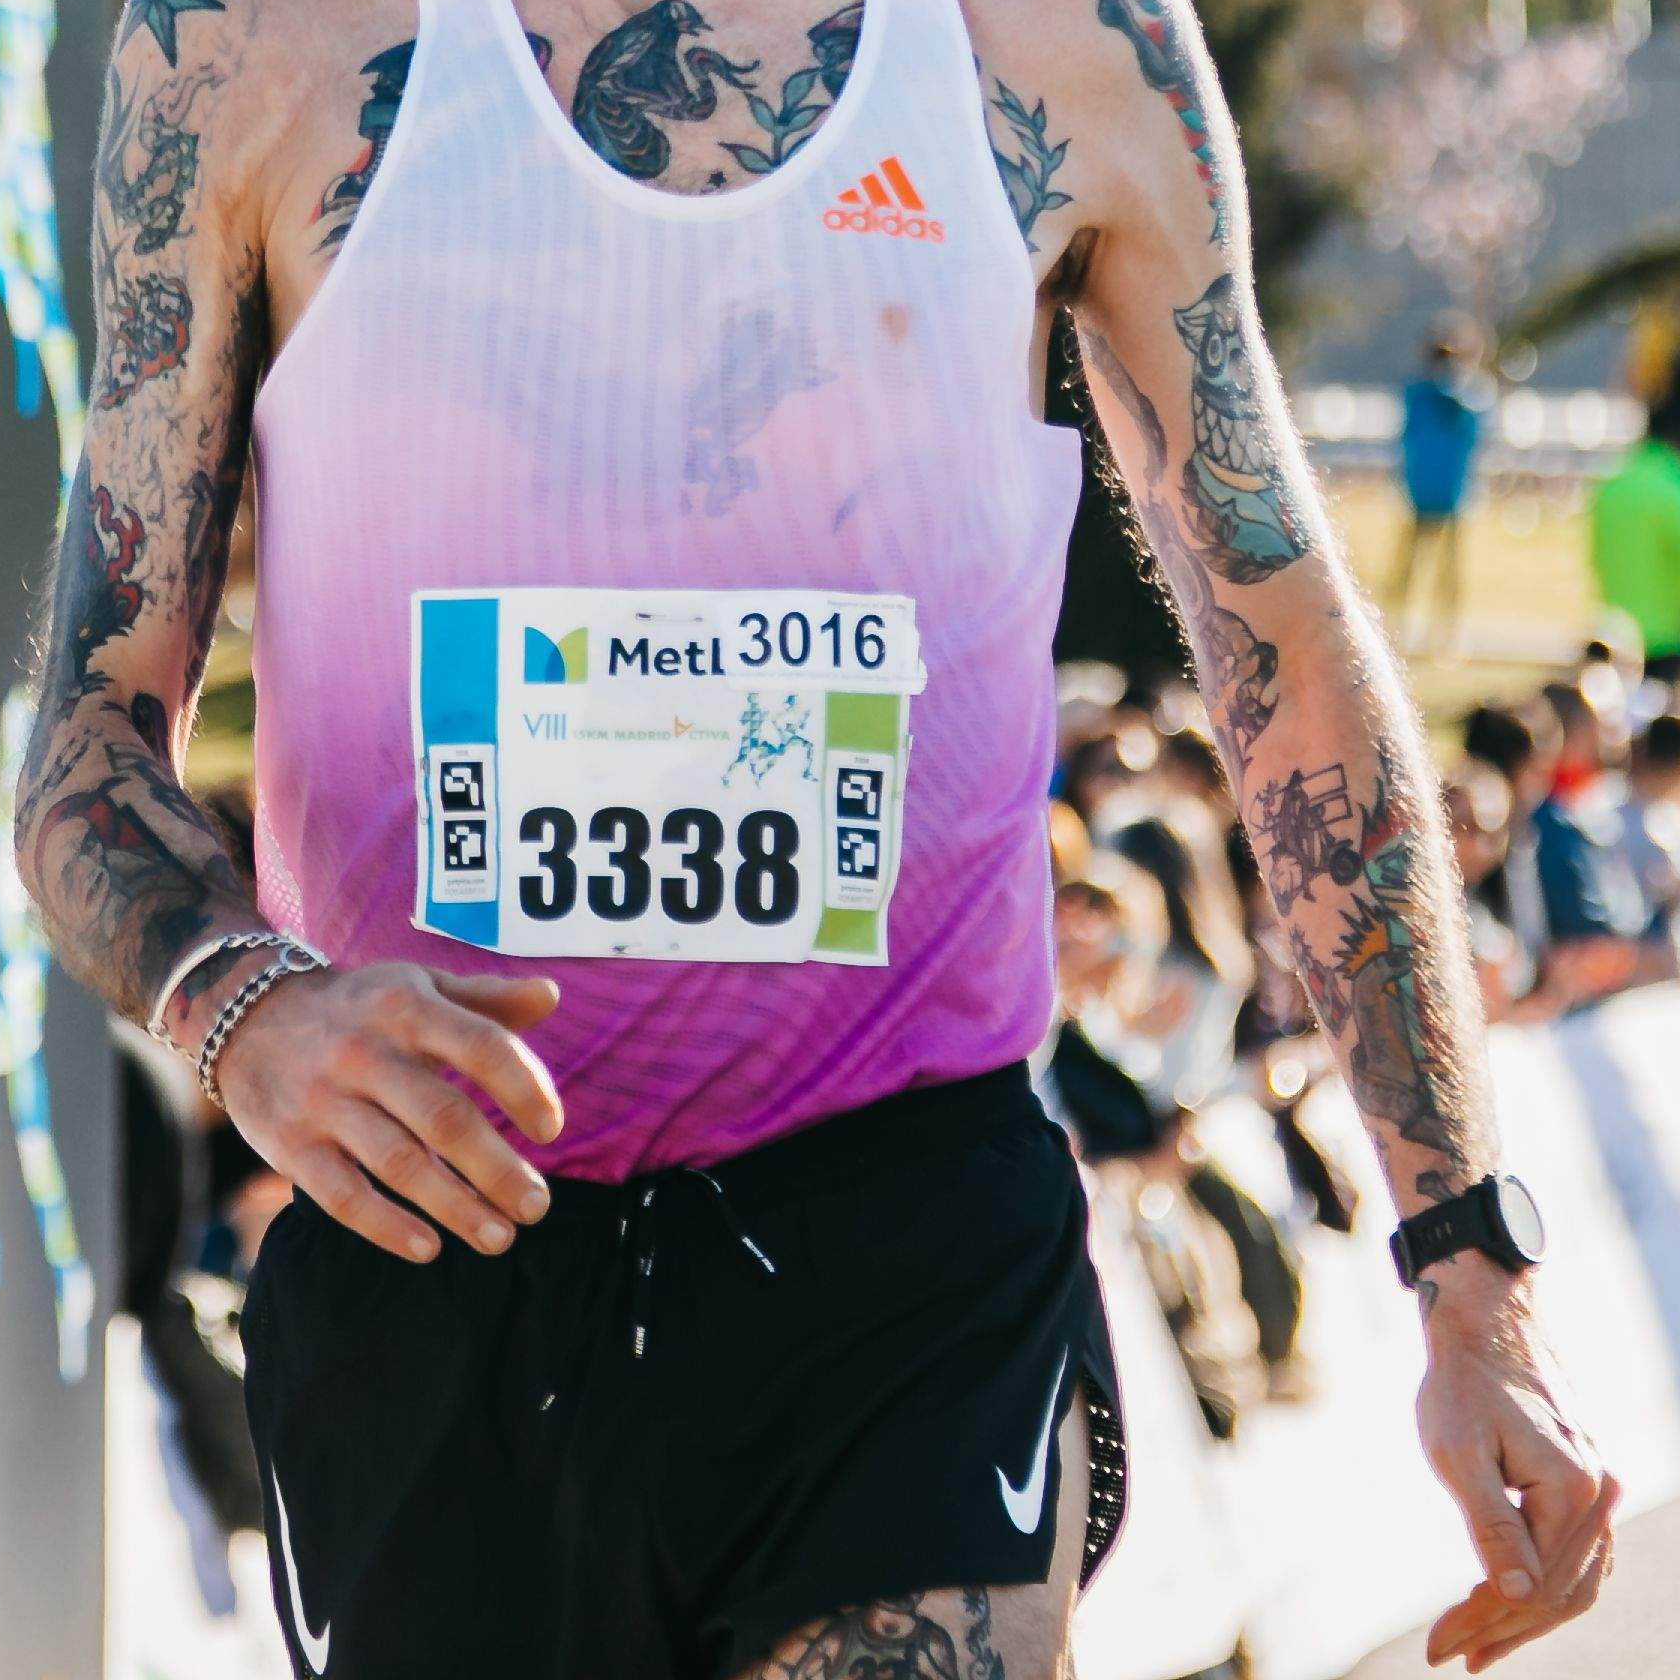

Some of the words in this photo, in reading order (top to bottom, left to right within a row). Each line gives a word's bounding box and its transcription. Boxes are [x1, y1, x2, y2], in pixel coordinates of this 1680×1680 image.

[822, 204, 945, 243] adidas
[738, 610, 887, 670] 3016
[522, 713, 567, 740] VIII
[614, 729, 672, 742] MADRID
[518, 806, 800, 925] 3338
